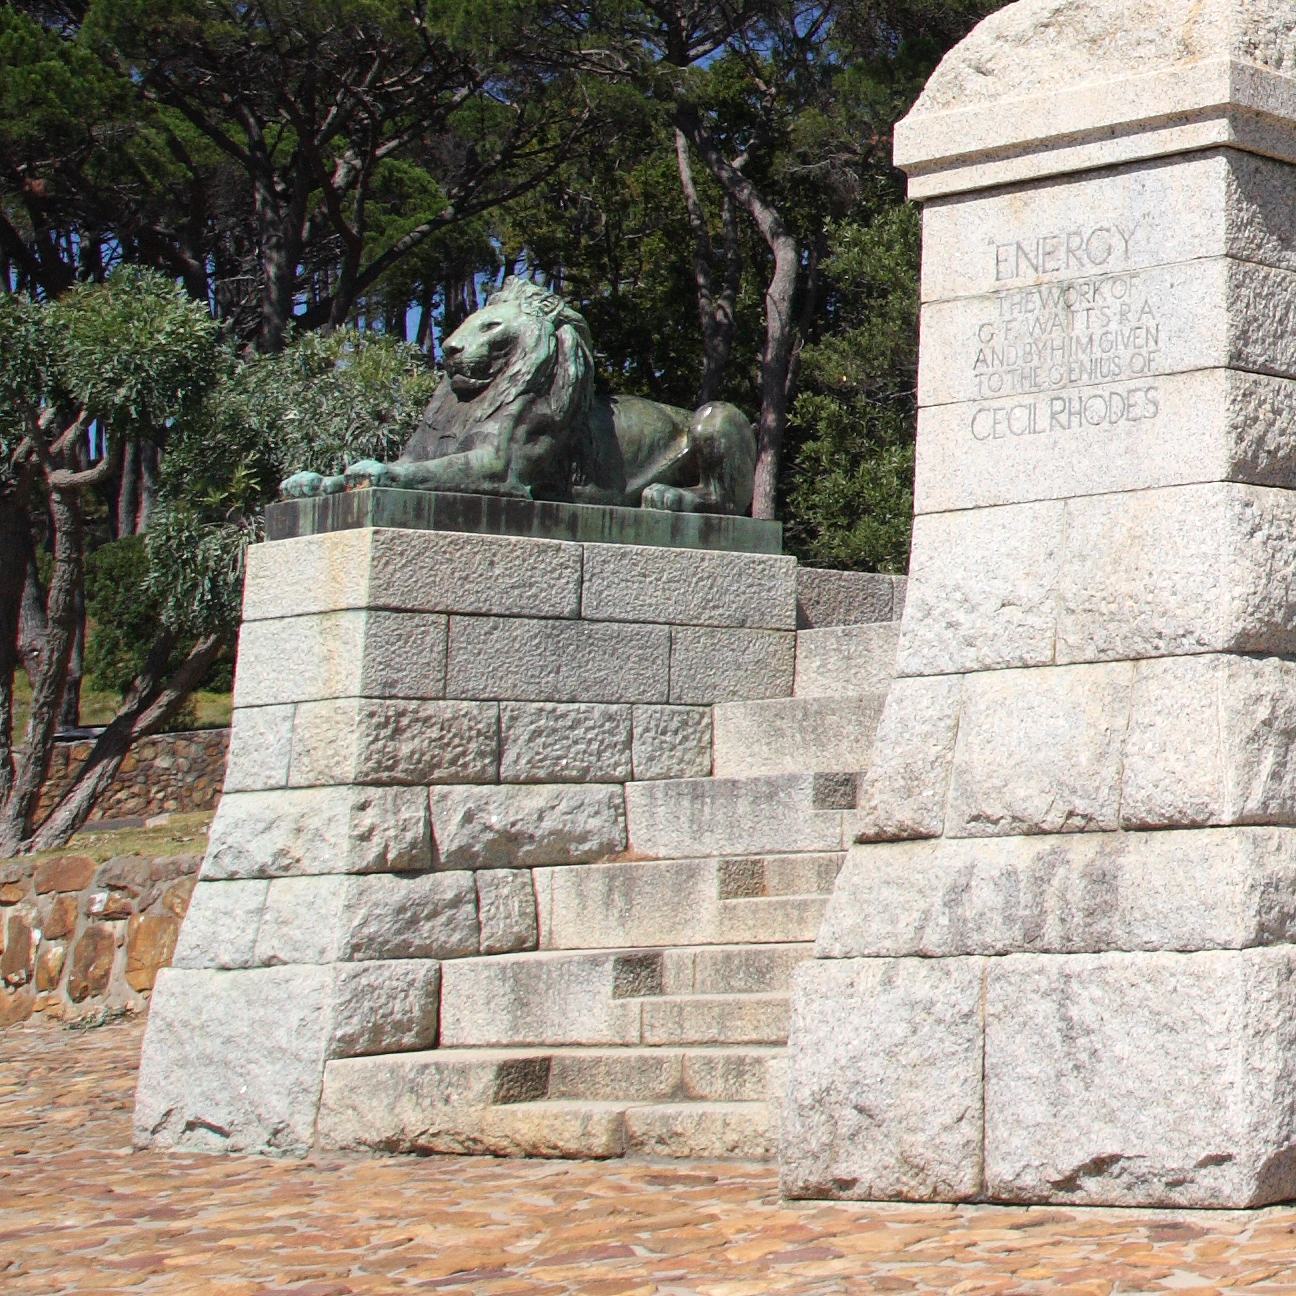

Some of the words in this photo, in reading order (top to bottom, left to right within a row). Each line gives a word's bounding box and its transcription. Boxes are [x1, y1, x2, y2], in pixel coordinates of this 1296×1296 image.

[996, 290, 1036, 317] THE
[1035, 279, 1106, 310] WORK
[1111, 275, 1141, 300] OF
[1026, 306, 1111, 337] WATTS
[973, 344, 1018, 371] AND
[1022, 340, 1047, 364] BY
[1050, 333, 1093, 360] HIM
[1099, 323, 1161, 354] GIVEN
[973, 372, 1004, 396] TO
[1005, 365, 1043, 391] THE
[1049, 355, 1122, 385] GENIUS
[1129, 348, 1161, 374] OF
[970, 402, 1046, 442] CECIL
[1049, 385, 1160, 431] RHODES
